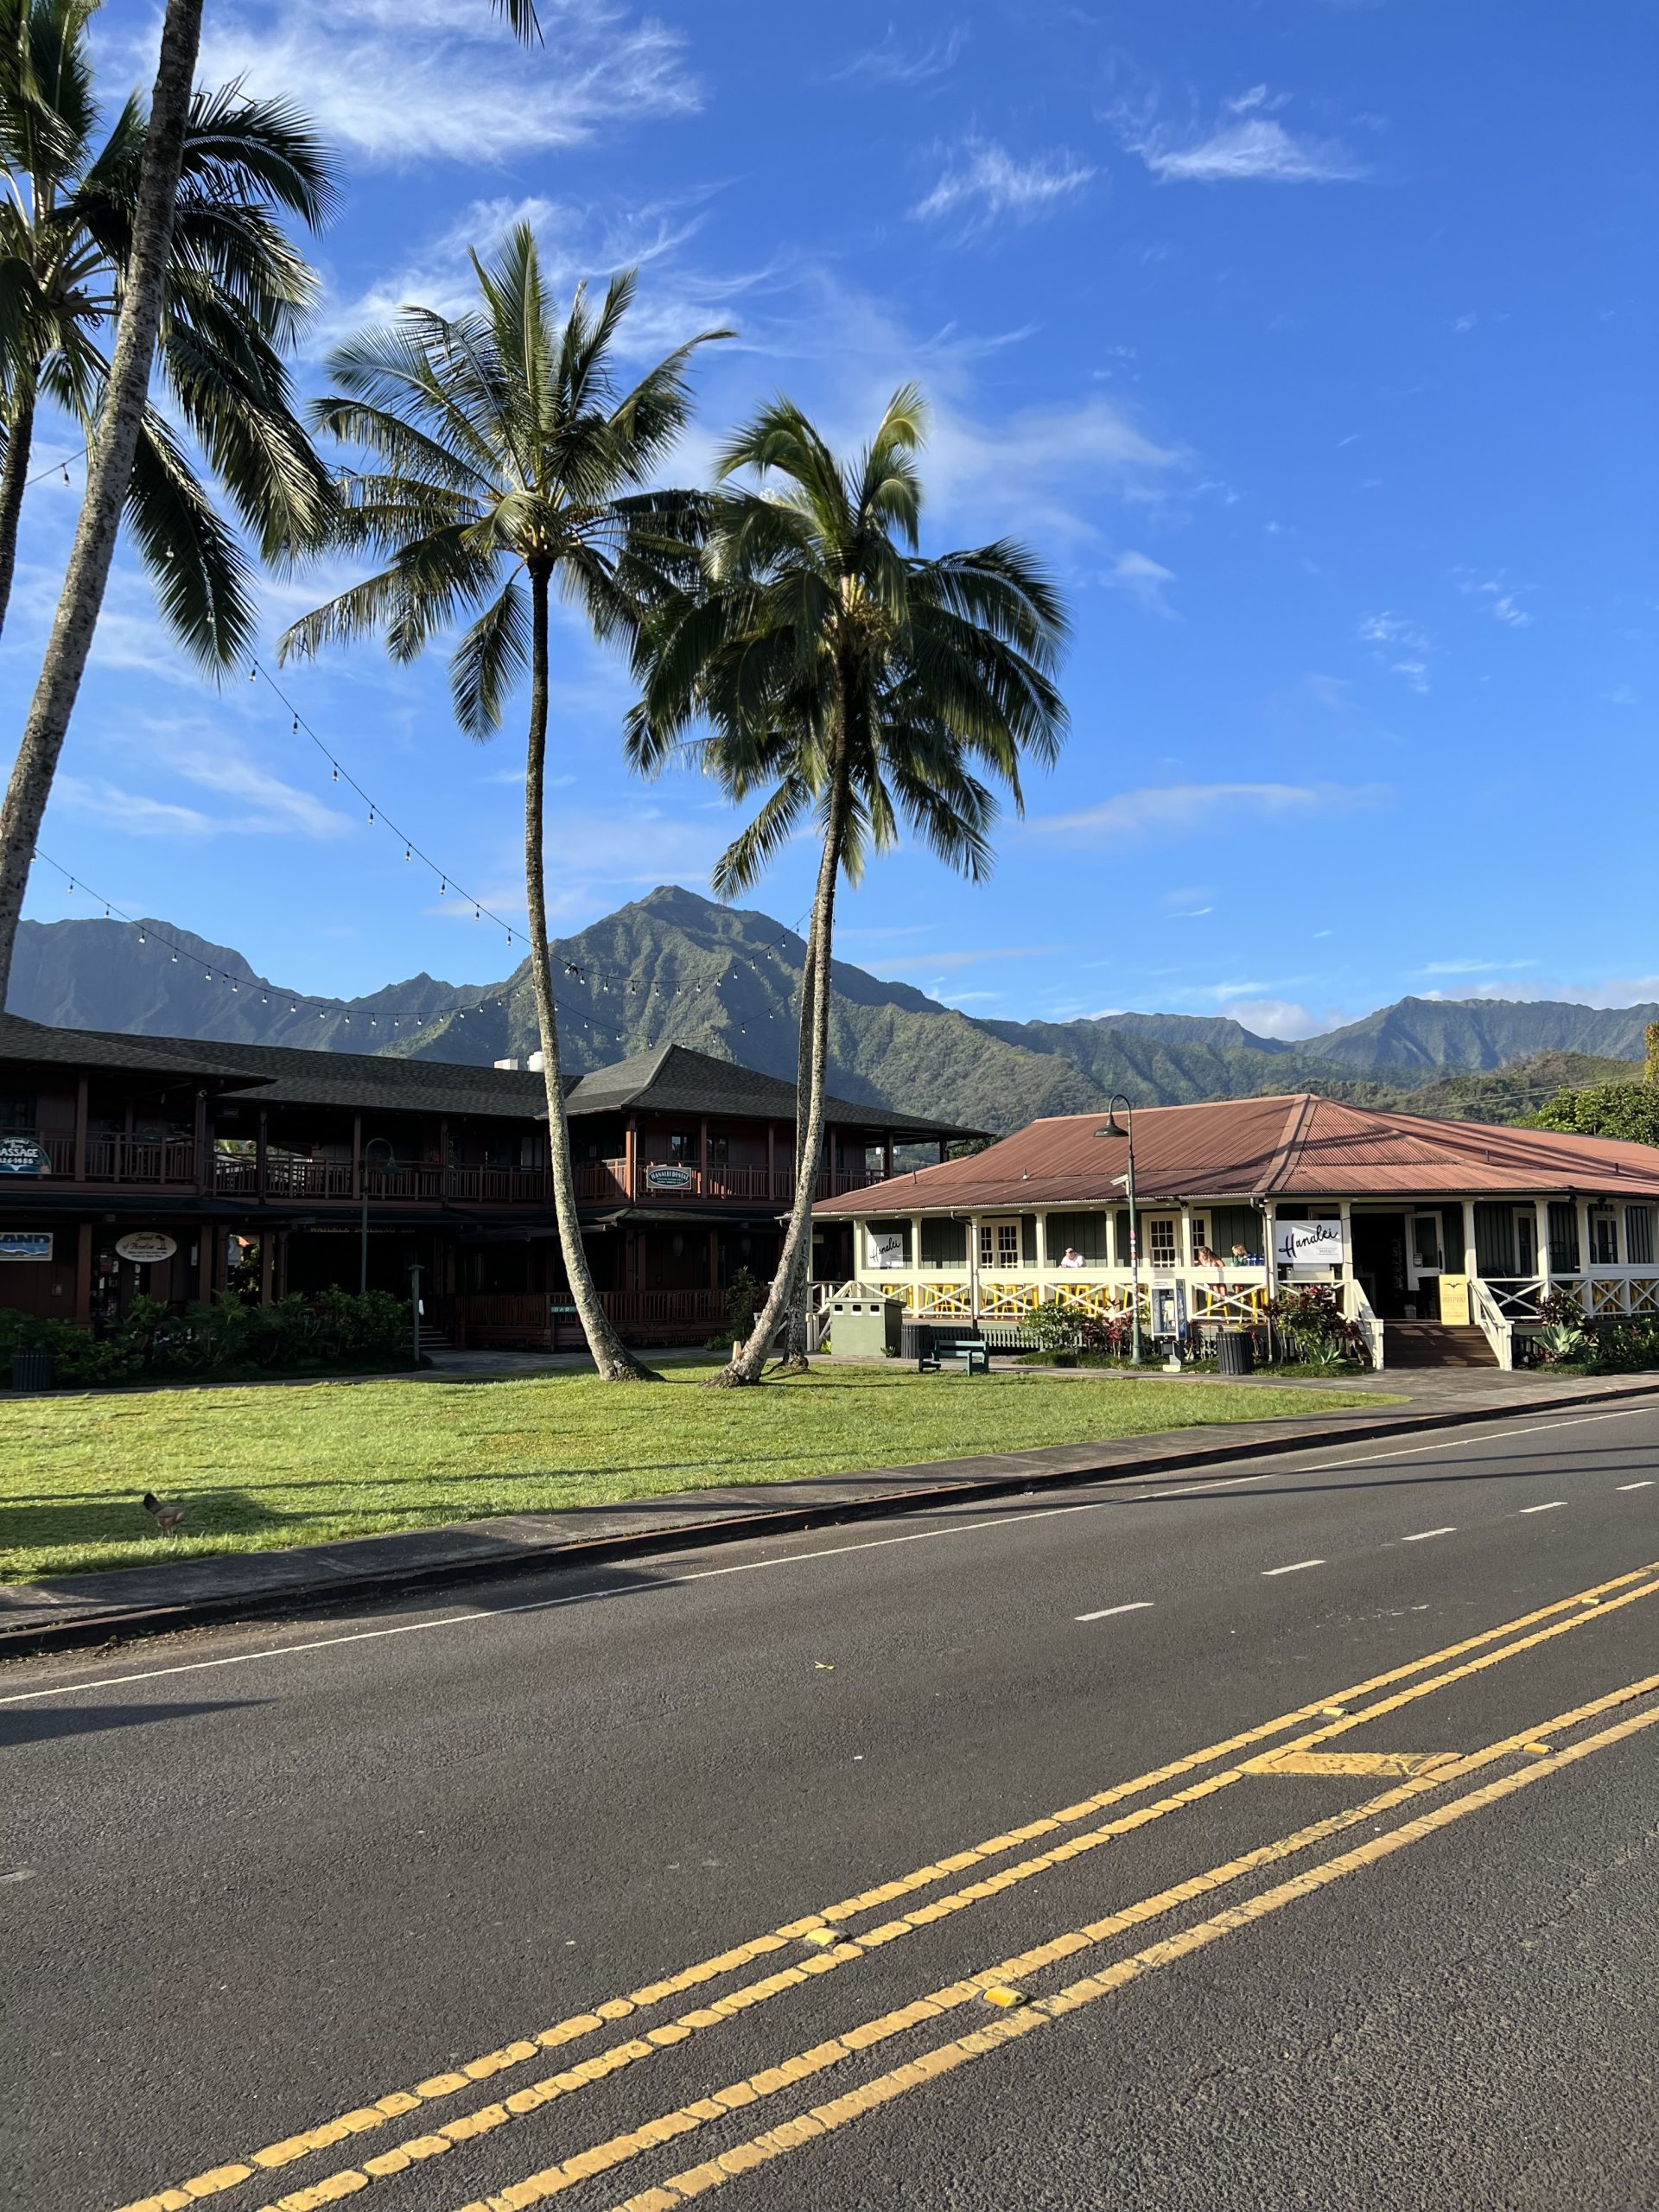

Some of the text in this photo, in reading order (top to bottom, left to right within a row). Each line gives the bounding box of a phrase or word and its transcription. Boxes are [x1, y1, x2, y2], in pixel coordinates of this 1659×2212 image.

[0, 1147, 39, 1157] ASSAGE
[0, 1234, 51, 1245] AND
[1278, 1224, 1338, 1259] Hanalei
